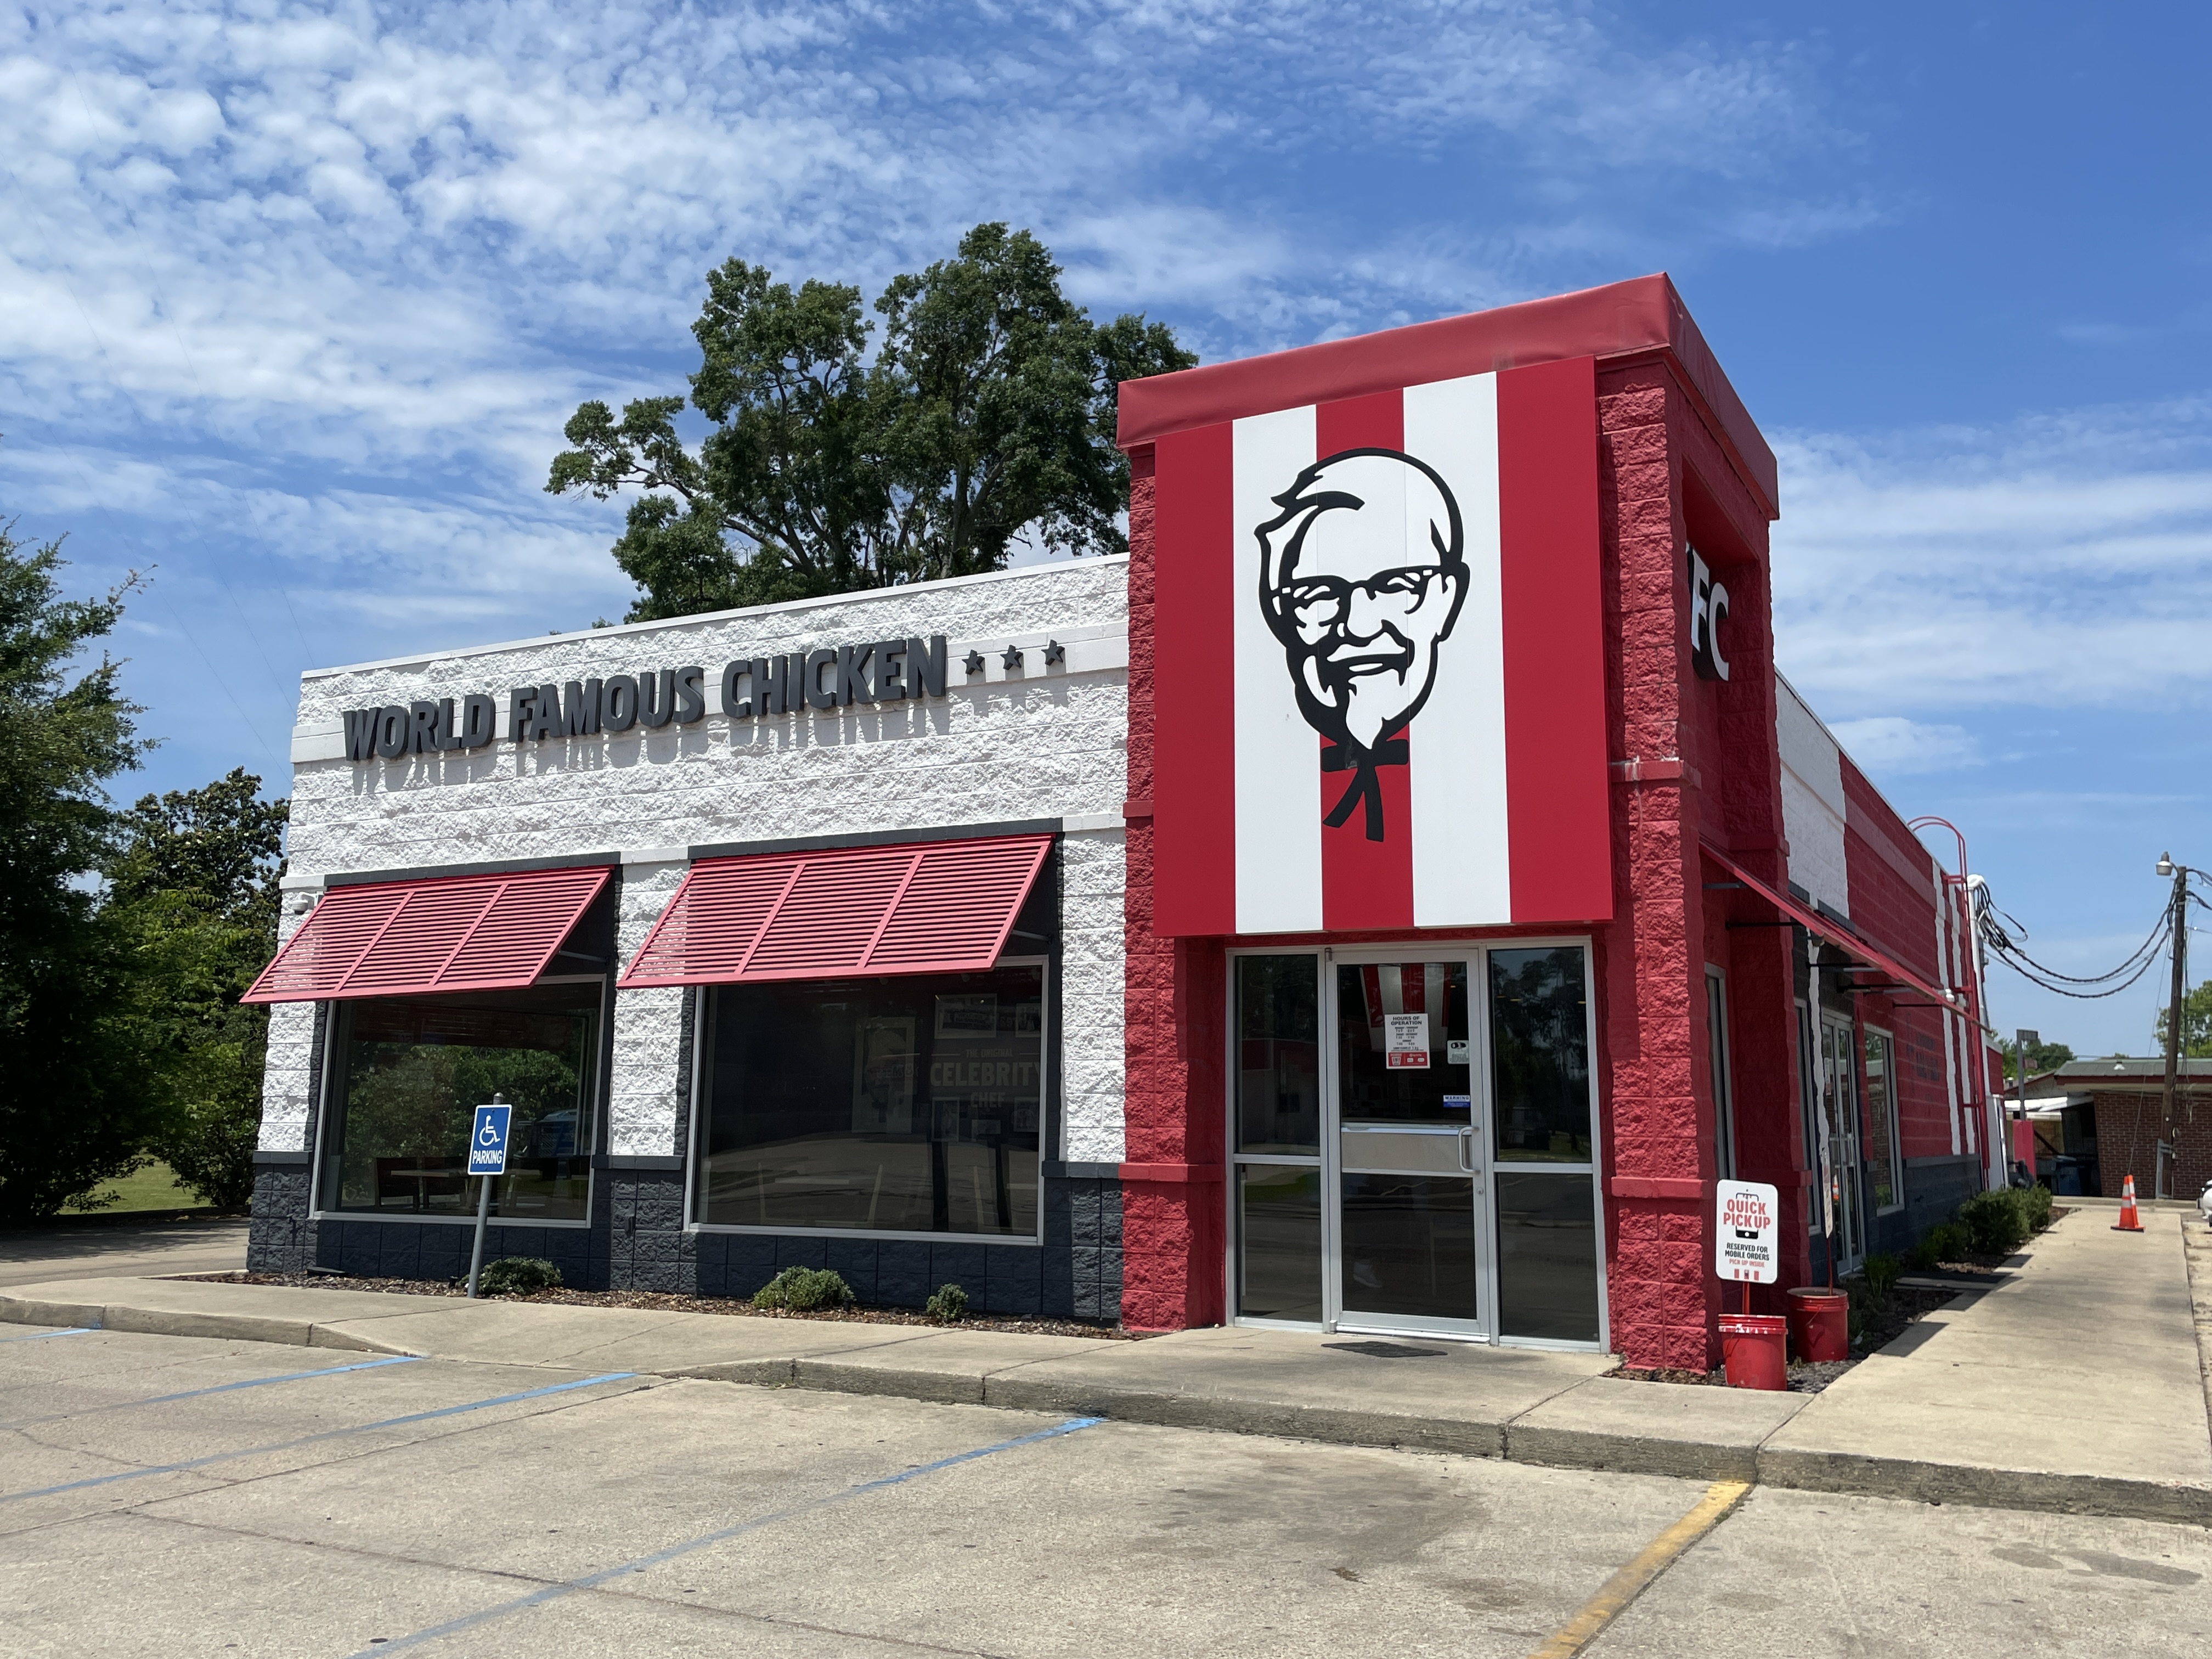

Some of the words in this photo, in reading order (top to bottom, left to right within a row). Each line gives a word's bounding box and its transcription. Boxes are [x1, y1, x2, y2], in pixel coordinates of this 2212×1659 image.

[1685, 541, 1729, 682] FC
[343, 694, 495, 761] WORLD
[508, 667, 705, 742] FAMOUS
[720, 635, 947, 719] CHICKEN
[966, 1048, 979, 1058] THE
[980, 1048, 1014, 1058] ORIGINAL
[970, 1091, 1006, 1108] CHEF
[472, 1150, 503, 1164] PARKING
[1727, 1199, 1766, 1215] QUICK
[1725, 1250, 1746, 1259] MOBILE
[1746, 1252, 1770, 1261] ORDERS
[1726, 1242, 1756, 1251] RESERVED
[1757, 1245, 1768, 1254] FOR
